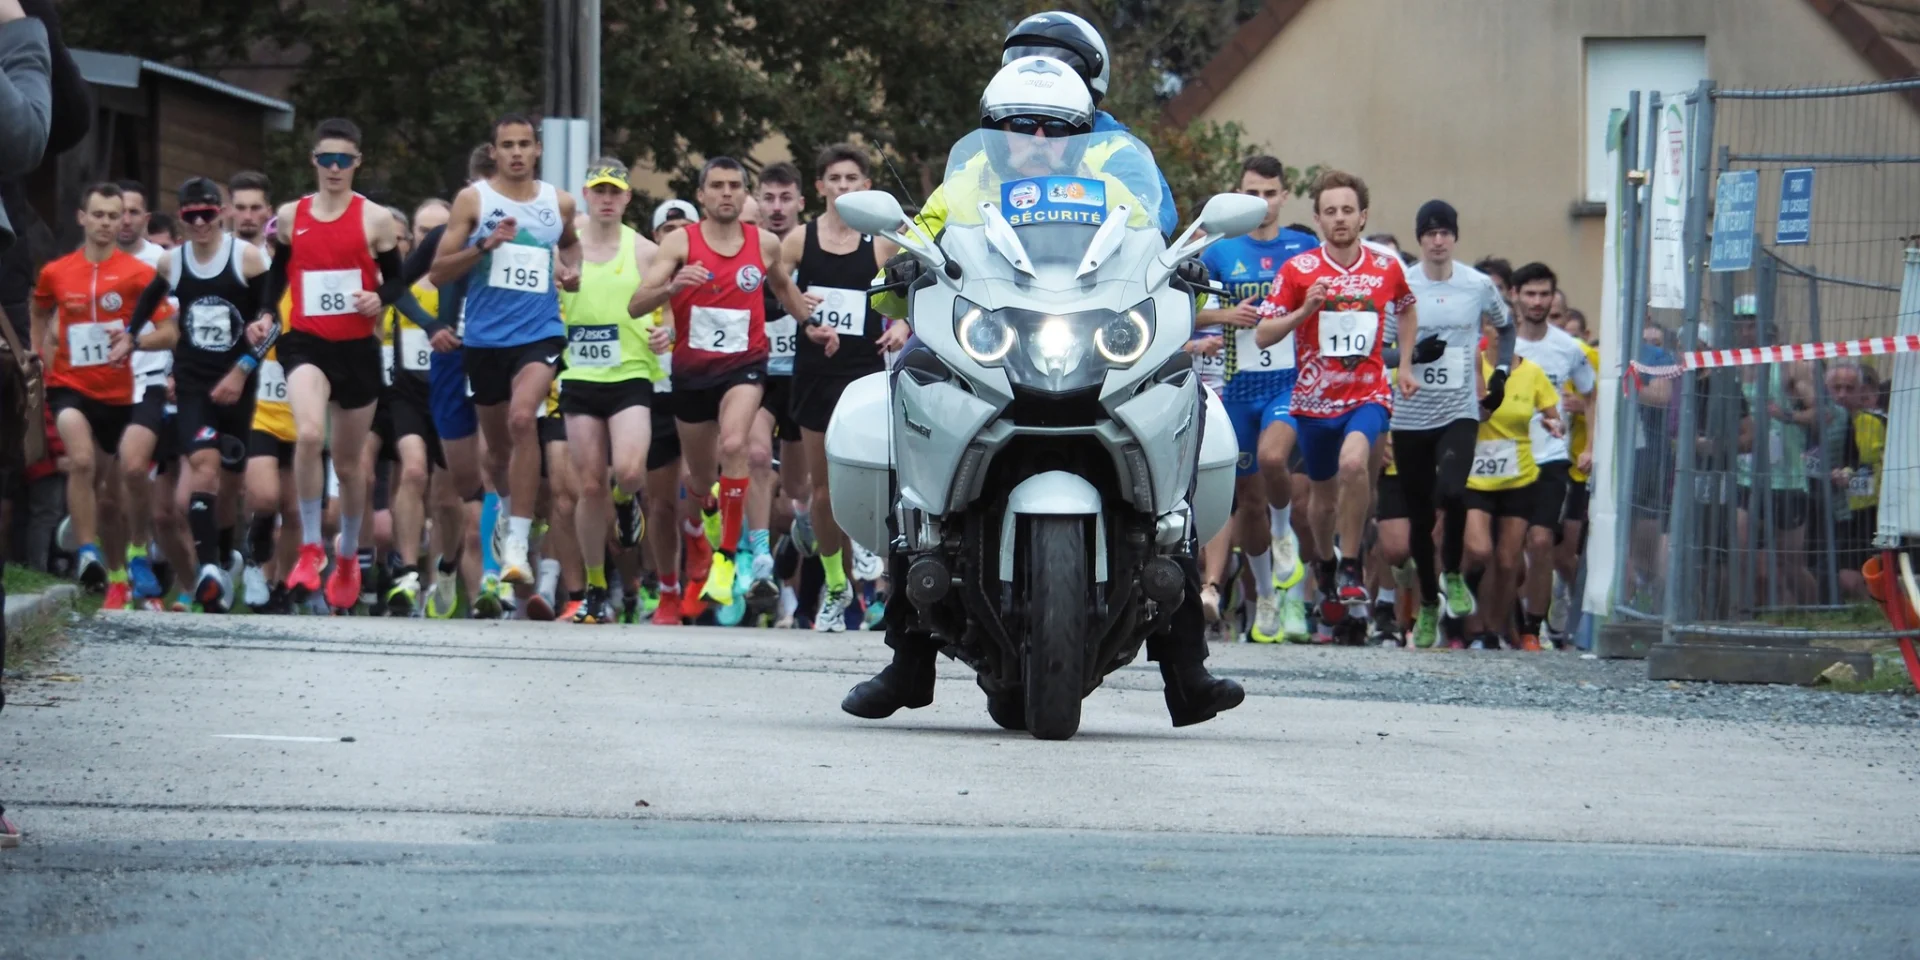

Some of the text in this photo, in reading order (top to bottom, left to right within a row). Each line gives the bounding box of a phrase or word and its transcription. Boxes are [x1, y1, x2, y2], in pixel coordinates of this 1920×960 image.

[1010, 210, 1101, 225] SÉCURITÉ
[503, 266, 540, 289] 195
[320, 292, 346, 311] 88
[816, 310, 853, 330] 194
[200, 326, 225, 342] 72
[713, 330, 725, 348] 2
[1329, 334, 1367, 352] 110
[81, 344, 112, 362] 11
[578, 344, 611, 359] 406
[1260, 349, 1272, 367] 3
[1424, 367, 1449, 385] 65
[265, 382, 287, 398] 16
[1475, 458, 1508, 474] 297
